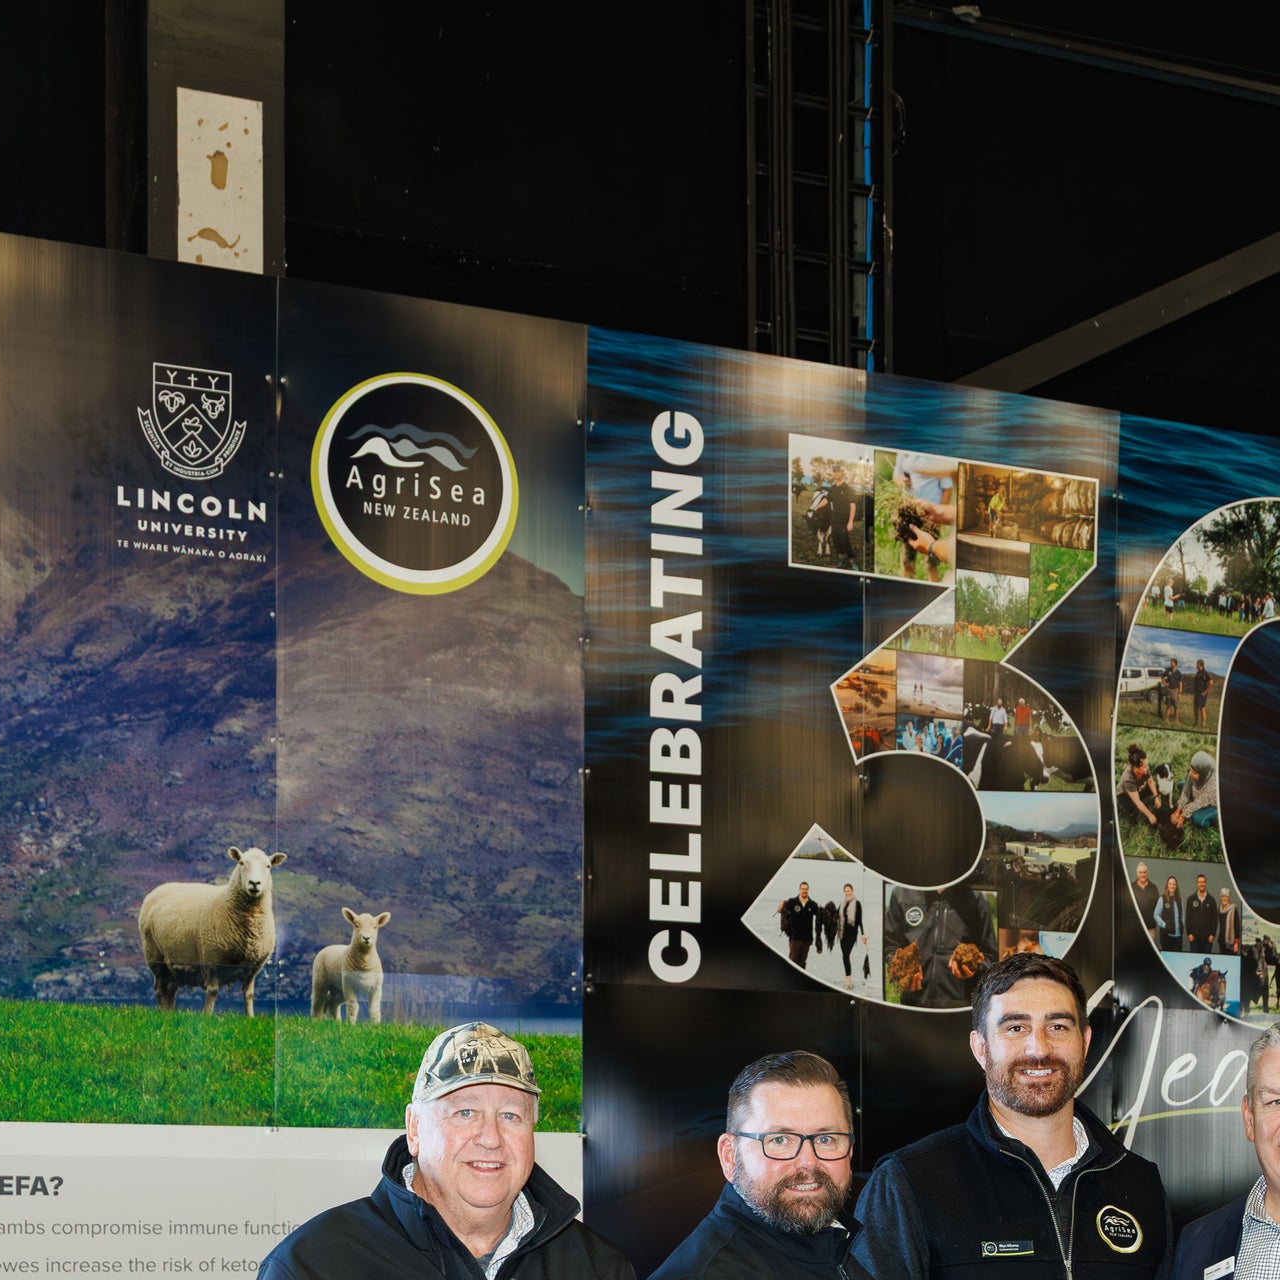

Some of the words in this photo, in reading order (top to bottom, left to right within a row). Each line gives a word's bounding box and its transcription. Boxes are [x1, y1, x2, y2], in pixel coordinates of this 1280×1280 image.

[346, 464, 485, 505] AgriSea
[117, 485, 267, 523] LINCOLN
[363, 501, 397, 518] NEW
[403, 506, 471, 527] ZEALAND
[138, 520, 247, 542] UNIVERSITY
[117, 539, 129, 548] TE
[133, 540, 170, 553] WHARE
[218, 549, 225, 558] O
[229, 550, 267, 562] AORAKI
[648, 410, 704, 985] CELEBRATING
[51, 1221, 164, 1240] compromise
[168, 1220, 239, 1235] immune
